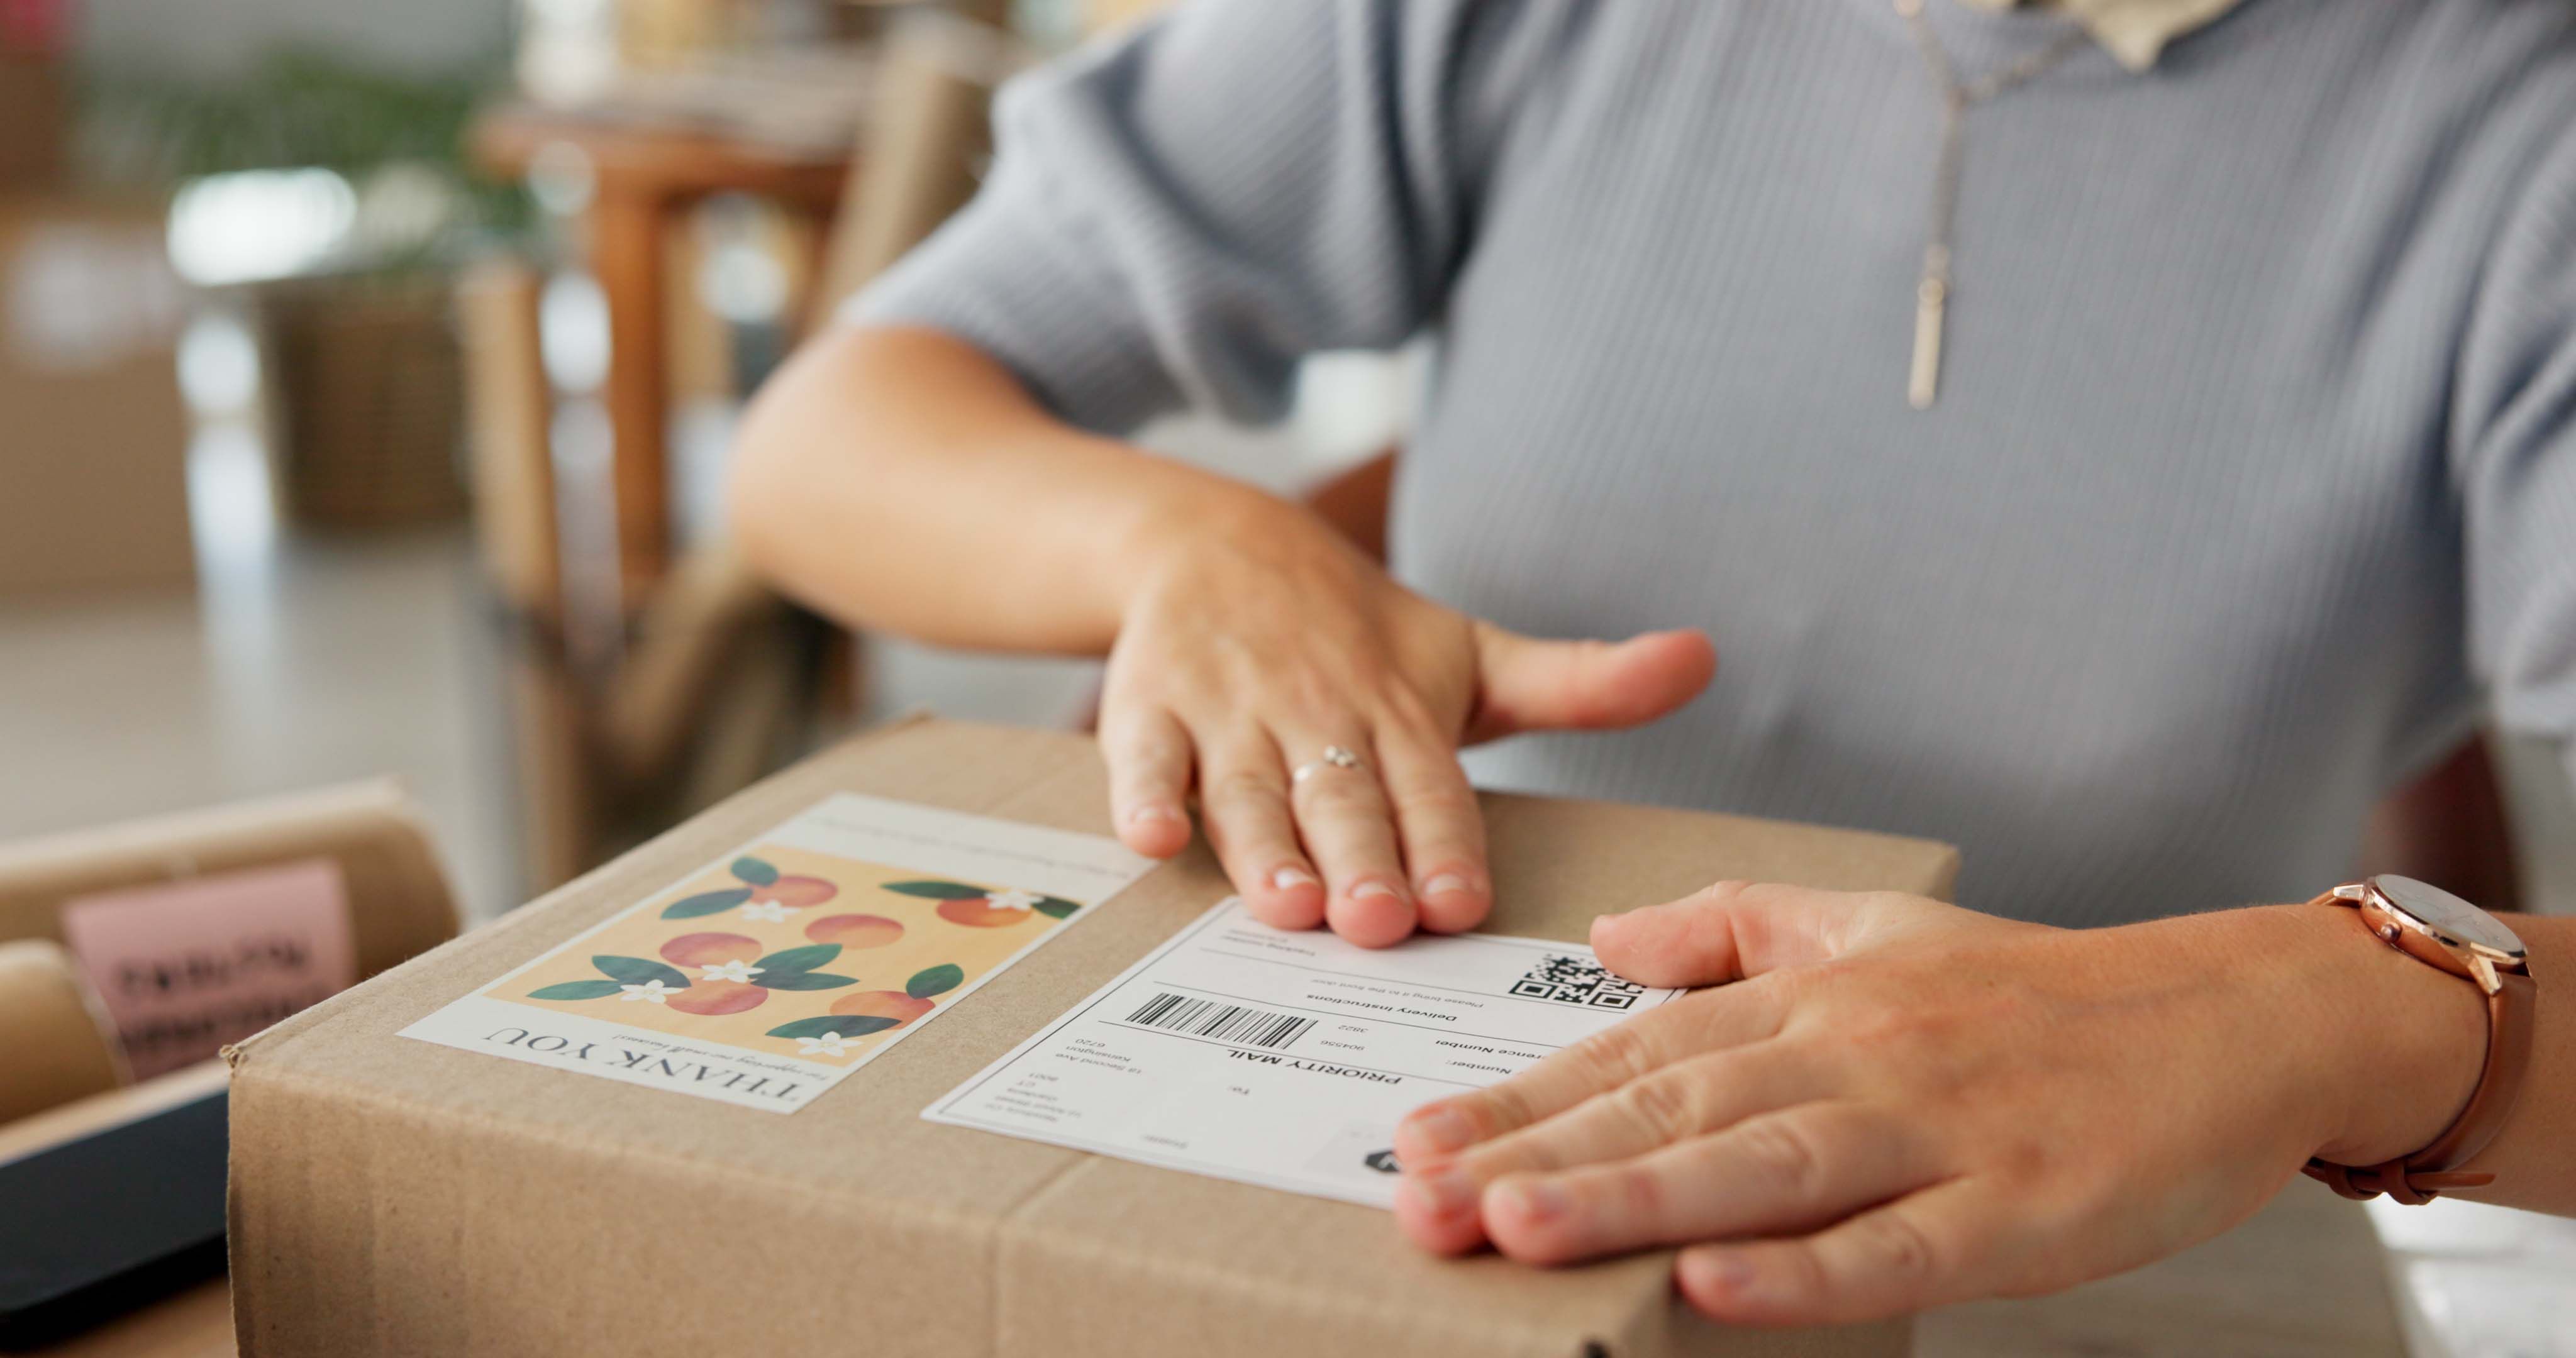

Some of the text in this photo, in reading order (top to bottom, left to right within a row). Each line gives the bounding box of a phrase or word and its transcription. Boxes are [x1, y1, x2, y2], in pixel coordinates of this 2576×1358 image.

[1340, 983, 1365, 991] front
[1413, 993, 1441, 1002] bring
[1445, 998, 1484, 1008] Please
[1306, 993, 1457, 1022] Delivery Instructions
[1338, 1024, 1368, 1034] 3822
[612, 1034, 670, 1051] business!
[1075, 1038, 1106, 1048] 6720
[1319, 1039, 1365, 1051] 904556
[667, 1046, 709, 1056] small
[1065, 1046, 1131, 1063] Kensington
[1434, 1039, 1542, 1060] rence Number
[1055, 1053, 1080, 1061] Ave
[482, 1027, 802, 1102] THANK YOU
[736, 1056, 802, 1075] supporting
[1080, 1058, 1126, 1071] Second
[1227, 1049, 1402, 1085] PRIORITY MAIL
[1445, 1059, 1512, 1075] Number:
